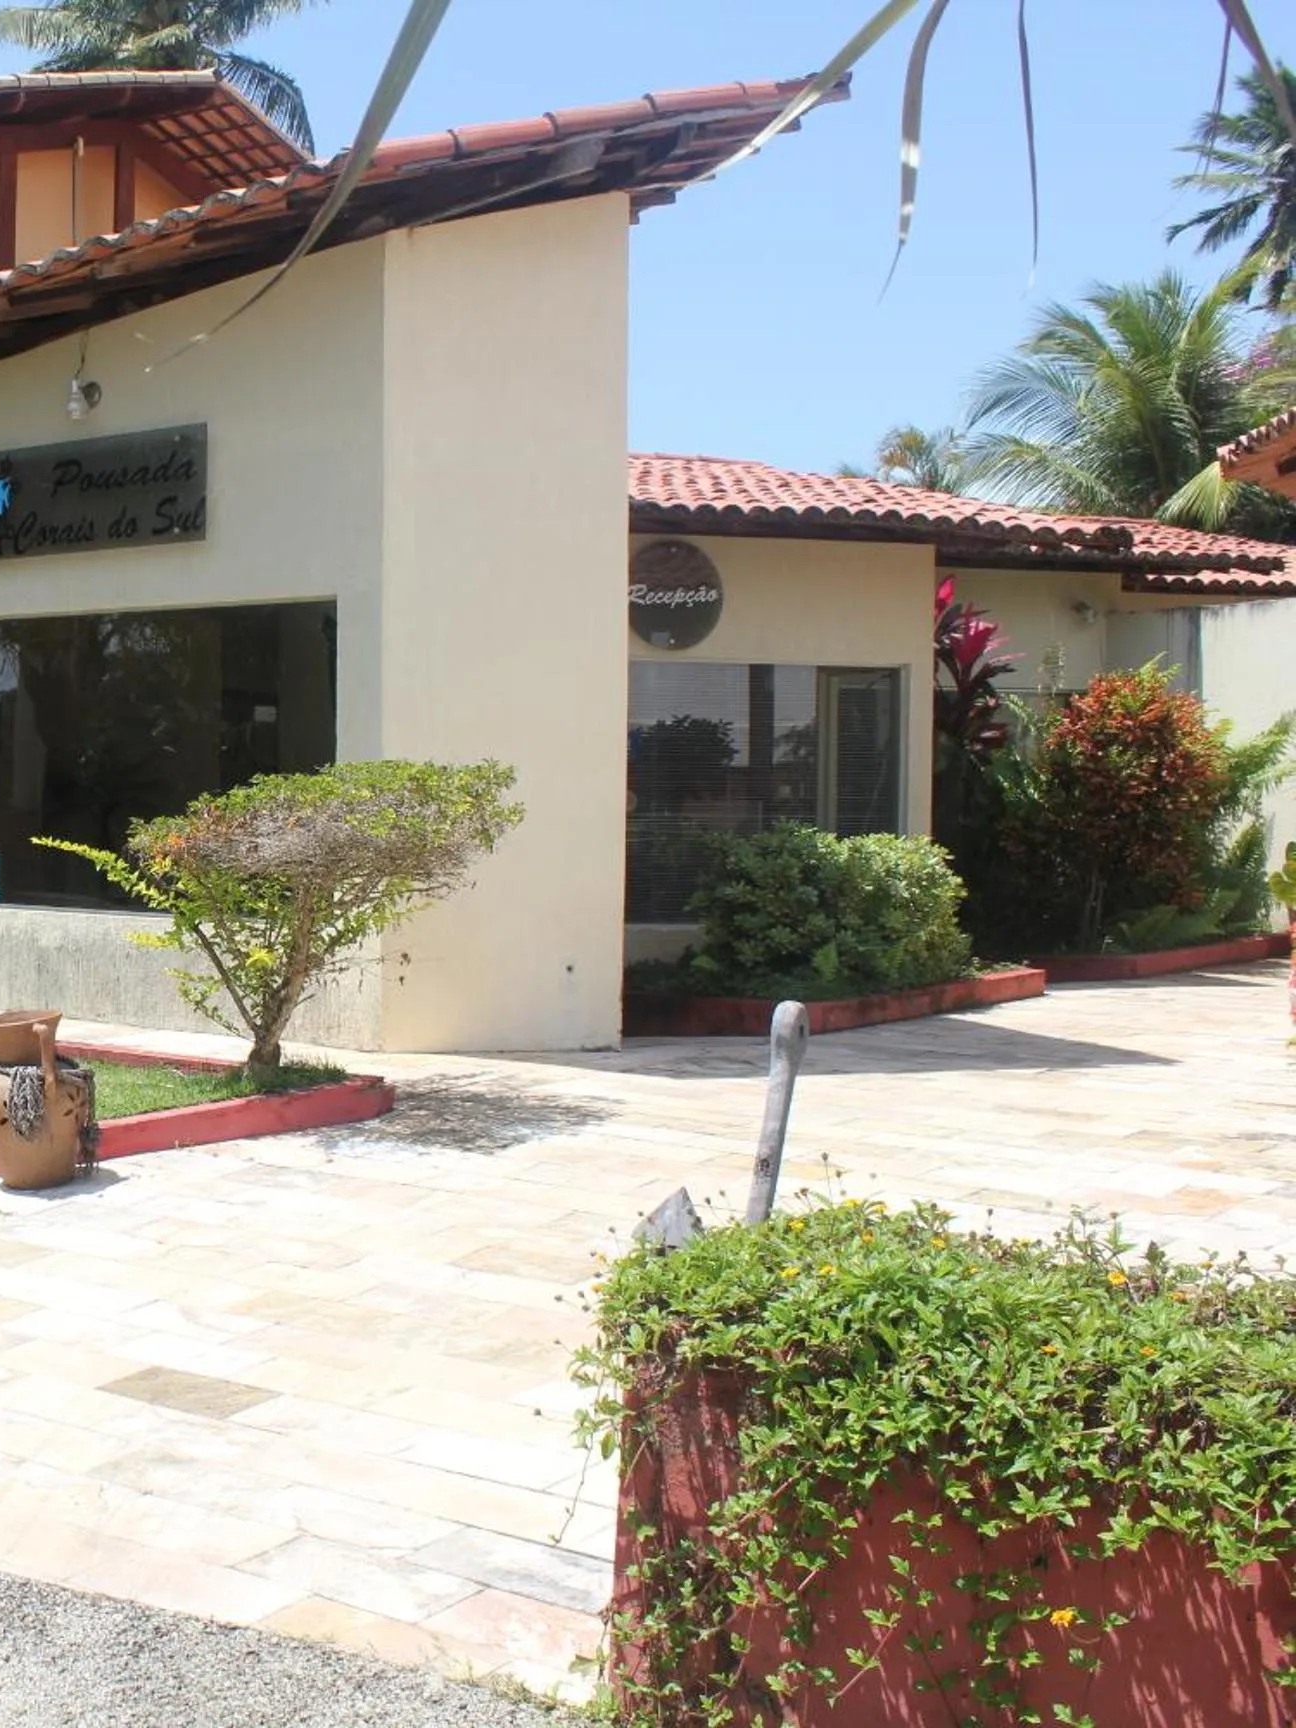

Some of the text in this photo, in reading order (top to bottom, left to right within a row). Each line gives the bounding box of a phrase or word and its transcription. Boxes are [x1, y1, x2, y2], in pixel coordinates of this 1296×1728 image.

[51, 452, 198, 497] Pousada
[11, 495, 206, 554] Corais do Sul
[627, 583, 718, 608] Recepção
